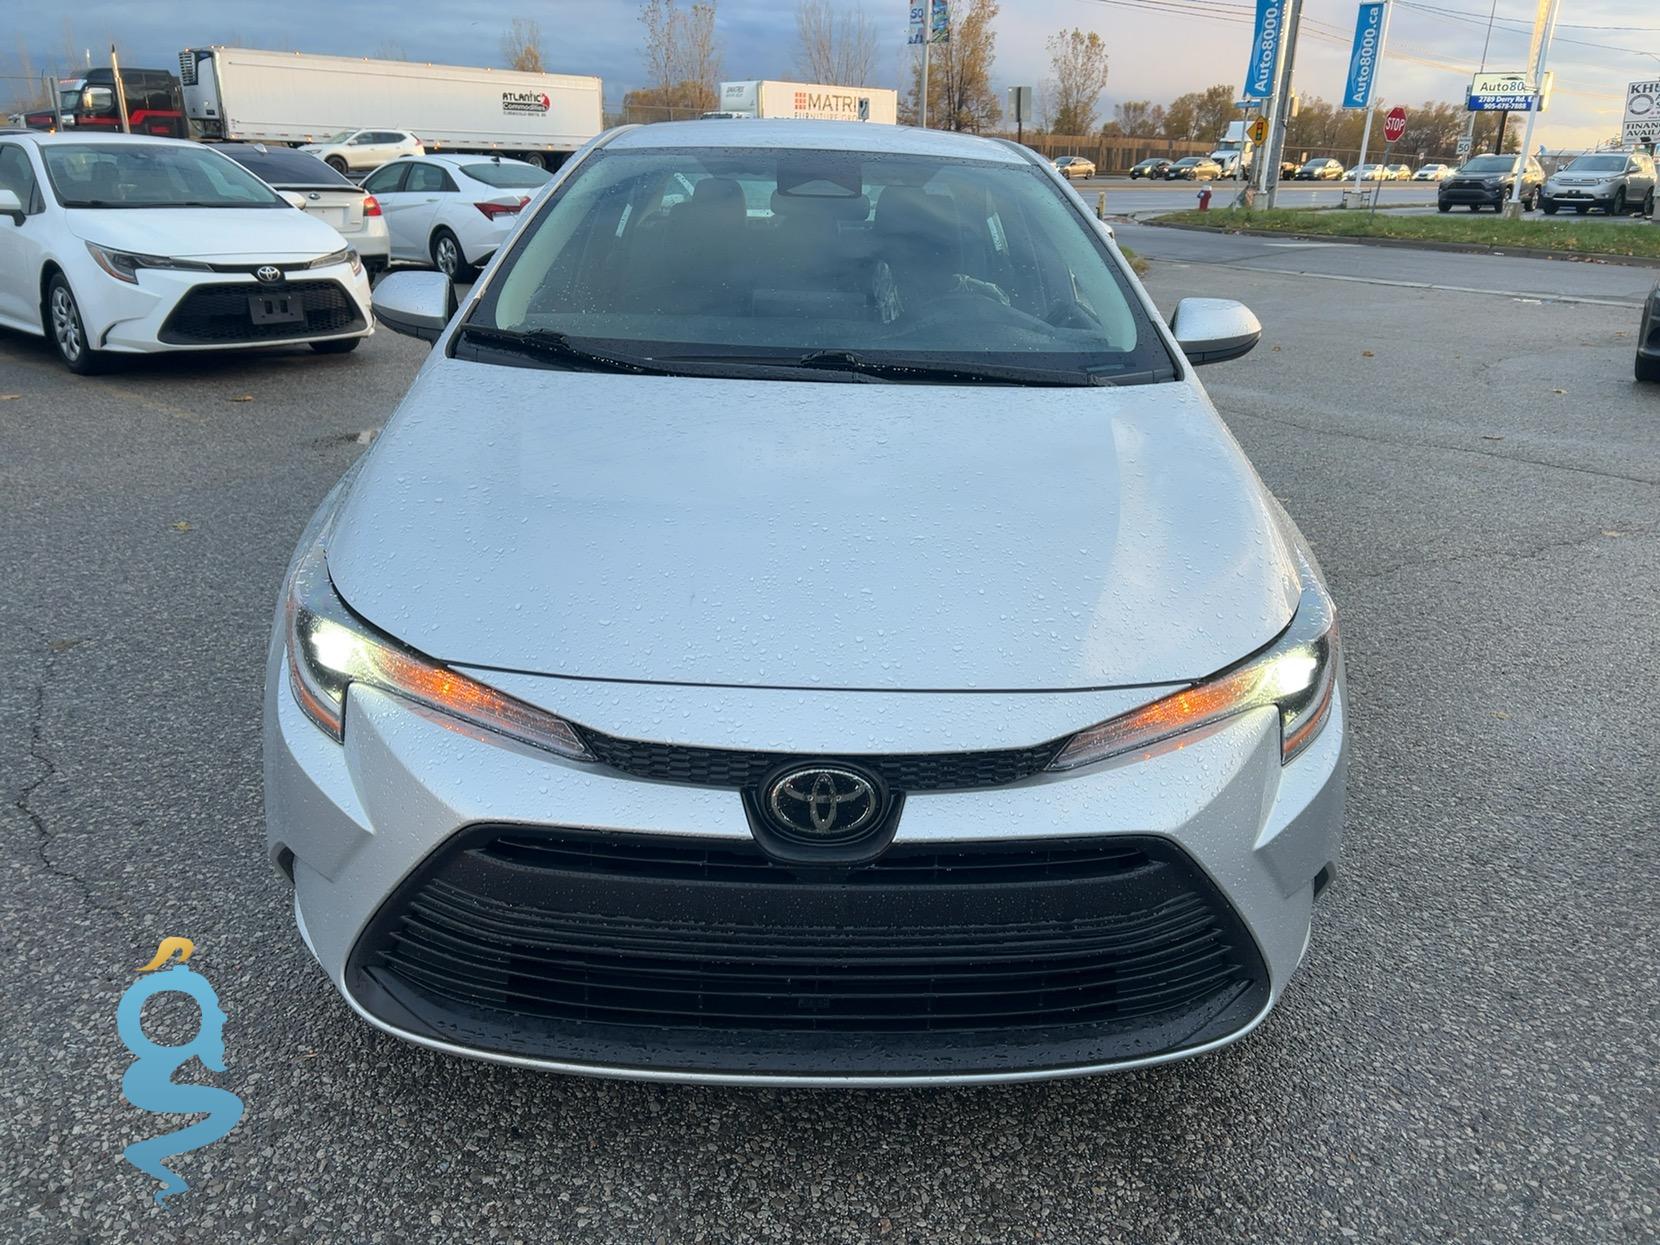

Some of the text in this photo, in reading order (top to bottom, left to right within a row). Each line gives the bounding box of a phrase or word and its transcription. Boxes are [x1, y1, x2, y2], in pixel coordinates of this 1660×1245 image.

[1255, 0, 1279, 92] Auto8000.
[1353, 7, 1379, 103] Auto8000.ca
[1480, 82, 1525, 92] Auto80
[808, 93, 859, 113] MATRI
[1496, 96, 1514, 104] Derry
[1385, 117, 1406, 132] STOP
[1626, 122, 1660, 130] FINAN
[1458, 143, 1470, 153] 50
